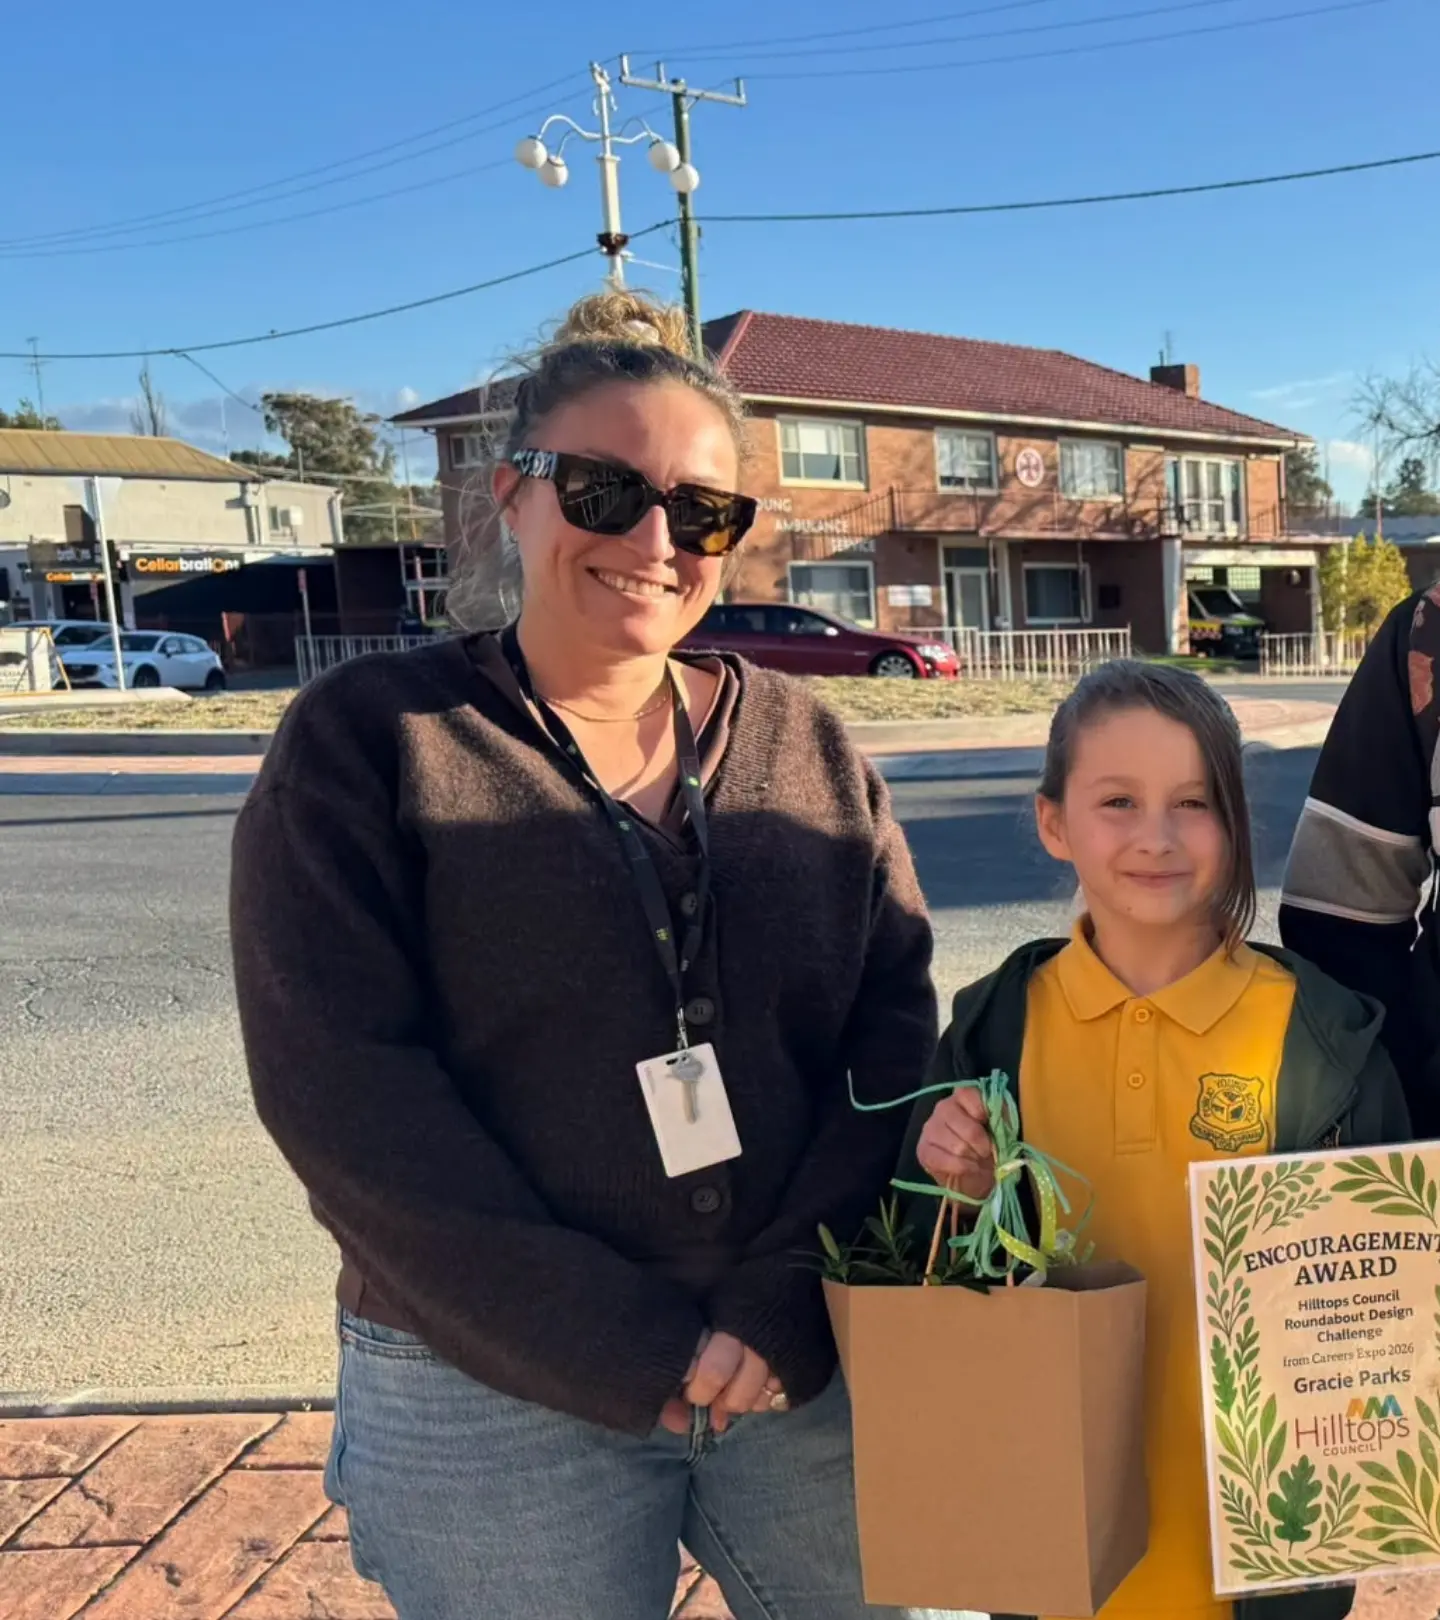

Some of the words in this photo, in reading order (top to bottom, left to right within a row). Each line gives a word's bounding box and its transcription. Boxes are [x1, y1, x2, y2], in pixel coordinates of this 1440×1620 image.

[757, 498, 792, 513] OUNG
[1294, 1255, 1398, 1286] AWARD
[1298, 1296, 1349, 1312] Hilltops
[1352, 1289, 1400, 1305] Council
[1284, 1309, 1365, 1330] Roundabout
[1369, 1306, 1413, 1322] Design
[1317, 1326, 1383, 1343] Challenge
[1283, 1355, 1310, 1368] from
[1312, 1349, 1354, 1364] Careers
[1356, 1347, 1386, 1362] Expo
[1388, 1342, 1414, 1355] 2026
[1294, 1372, 1353, 1394] Gracie
[1359, 1366, 1411, 1387] Parks
[1295, 1412, 1410, 1450] Hilltops
[1323, 1443, 1377, 1457] COUNCIL
